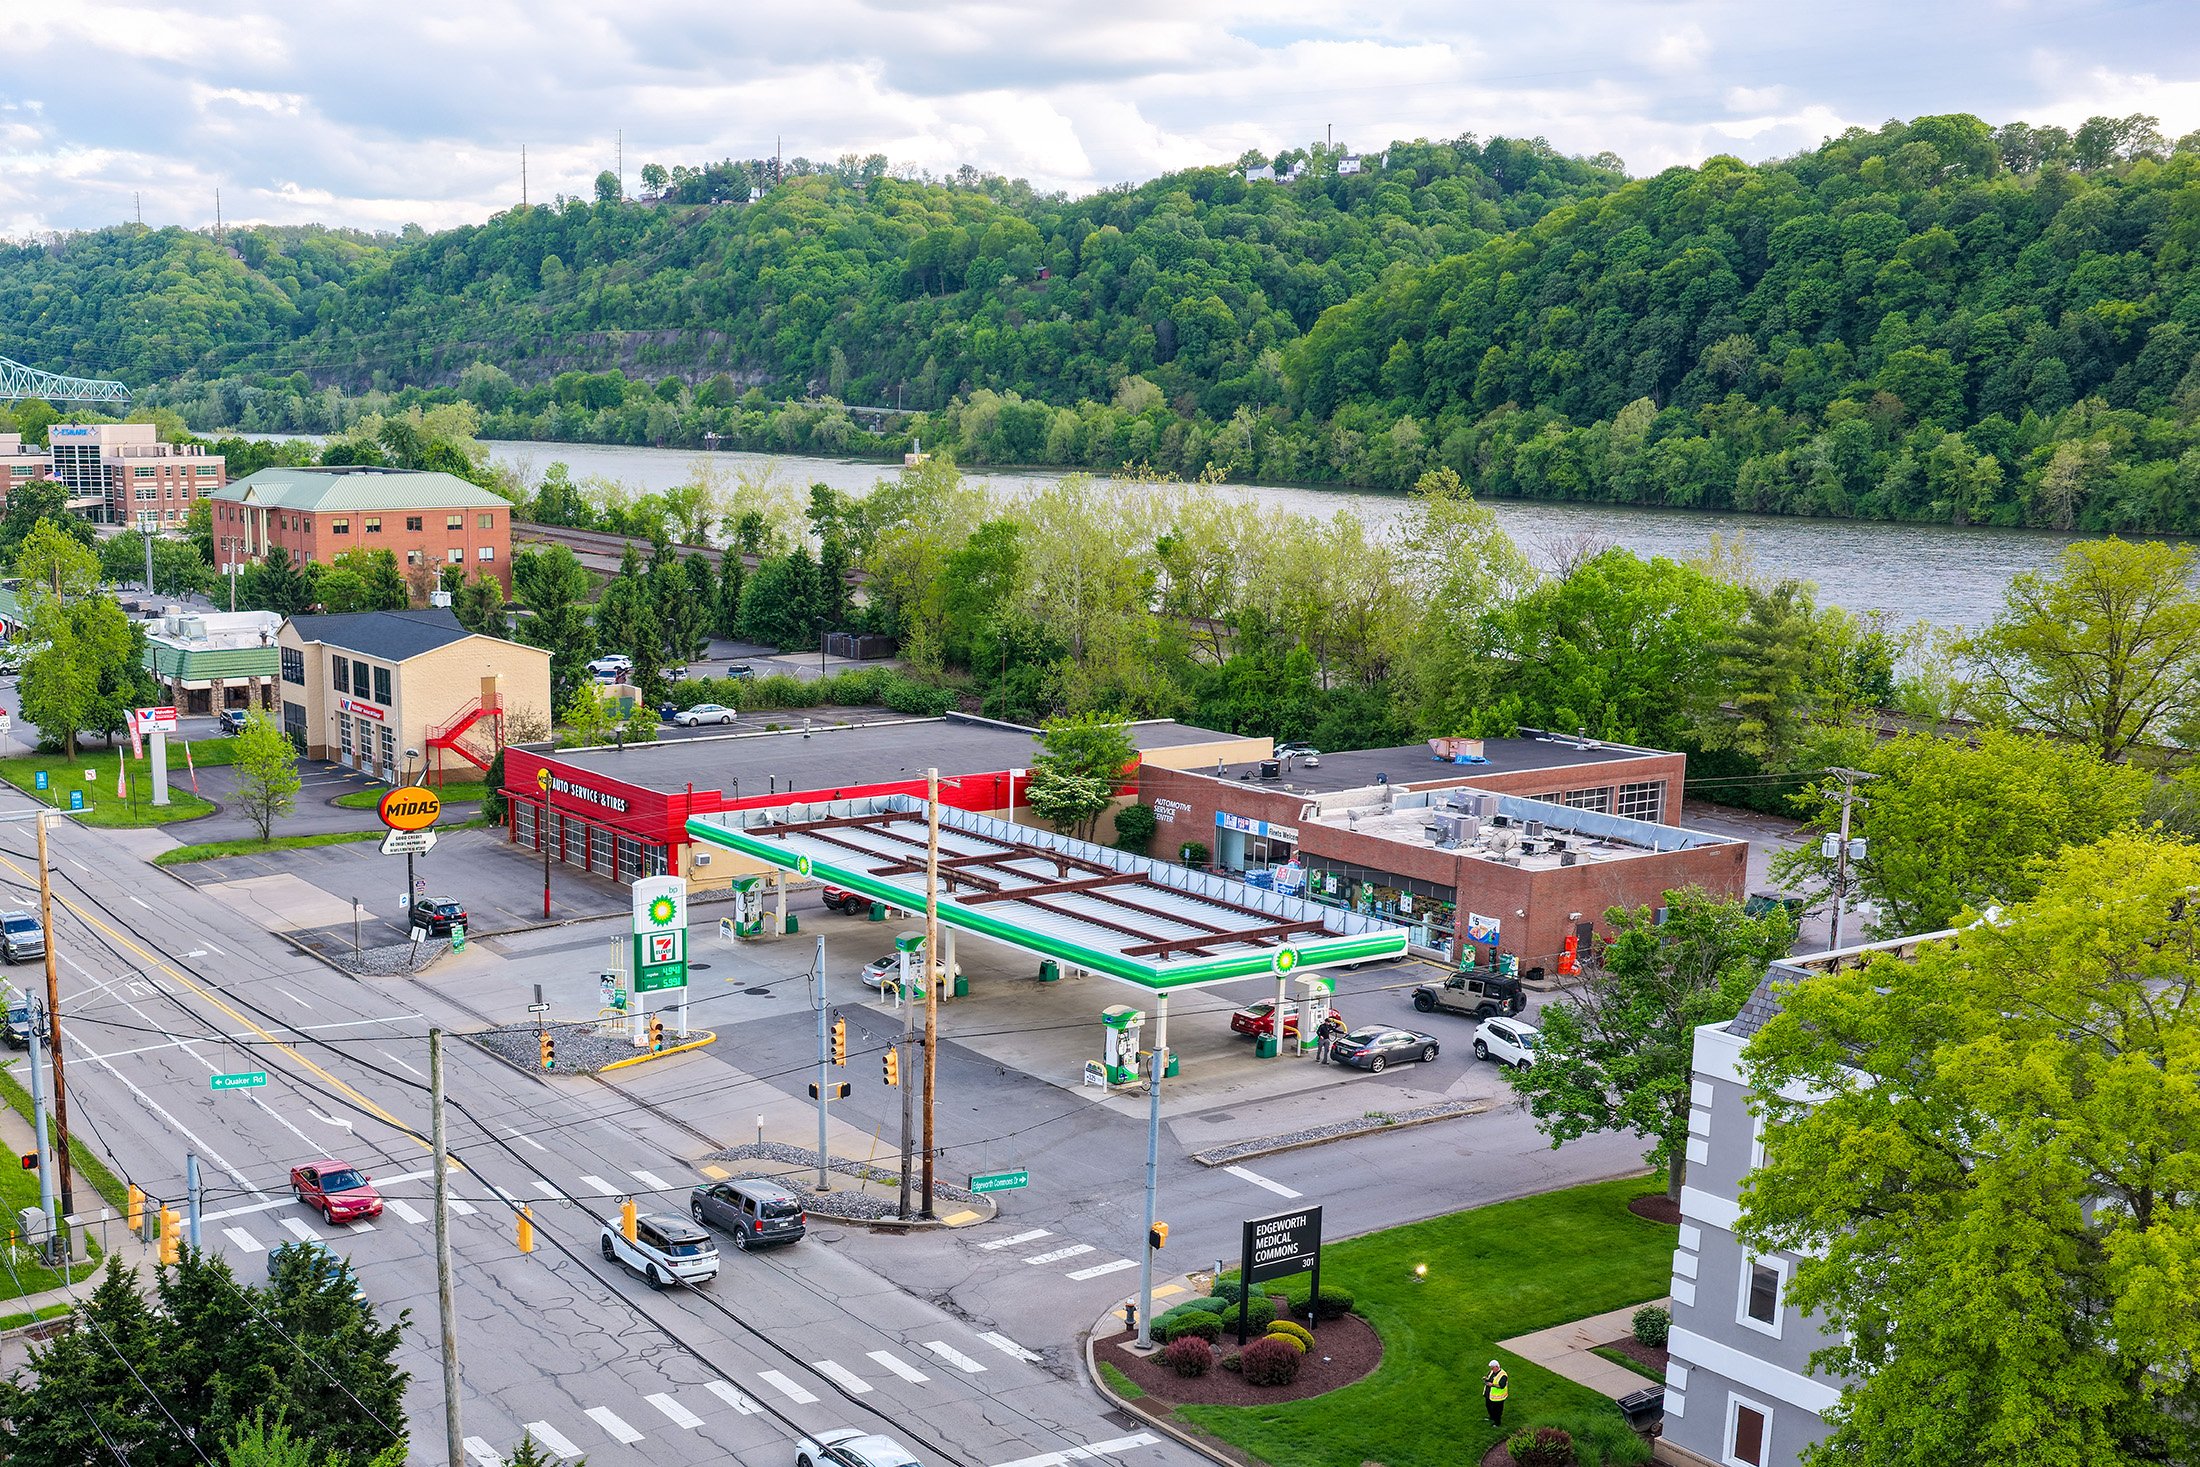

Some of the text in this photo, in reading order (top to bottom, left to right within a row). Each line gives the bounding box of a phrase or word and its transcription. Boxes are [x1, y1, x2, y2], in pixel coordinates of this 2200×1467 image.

[552, 777, 568, 793] AUTO
[570, 783, 598, 803] SERVICE
[386, 797, 438, 818] MIDAS
[1154, 797, 1192, 812] AUTOMOTIVE
[1154, 805, 1176, 816] SERVICE
[1154, 812, 1174, 823] CENTER
[668, 886, 678, 894] bp
[224, 1075, 263, 1086] Quaker Rd
[973, 1176, 1018, 1191] Edgeworth Commons Dr
[1256, 1215, 1307, 1236] EDGEWORTH
[1255, 1231, 1292, 1250] MEDICAL
[1255, 1242, 1299, 1262] COMMONS
[1302, 1257, 1314, 1268] 301
